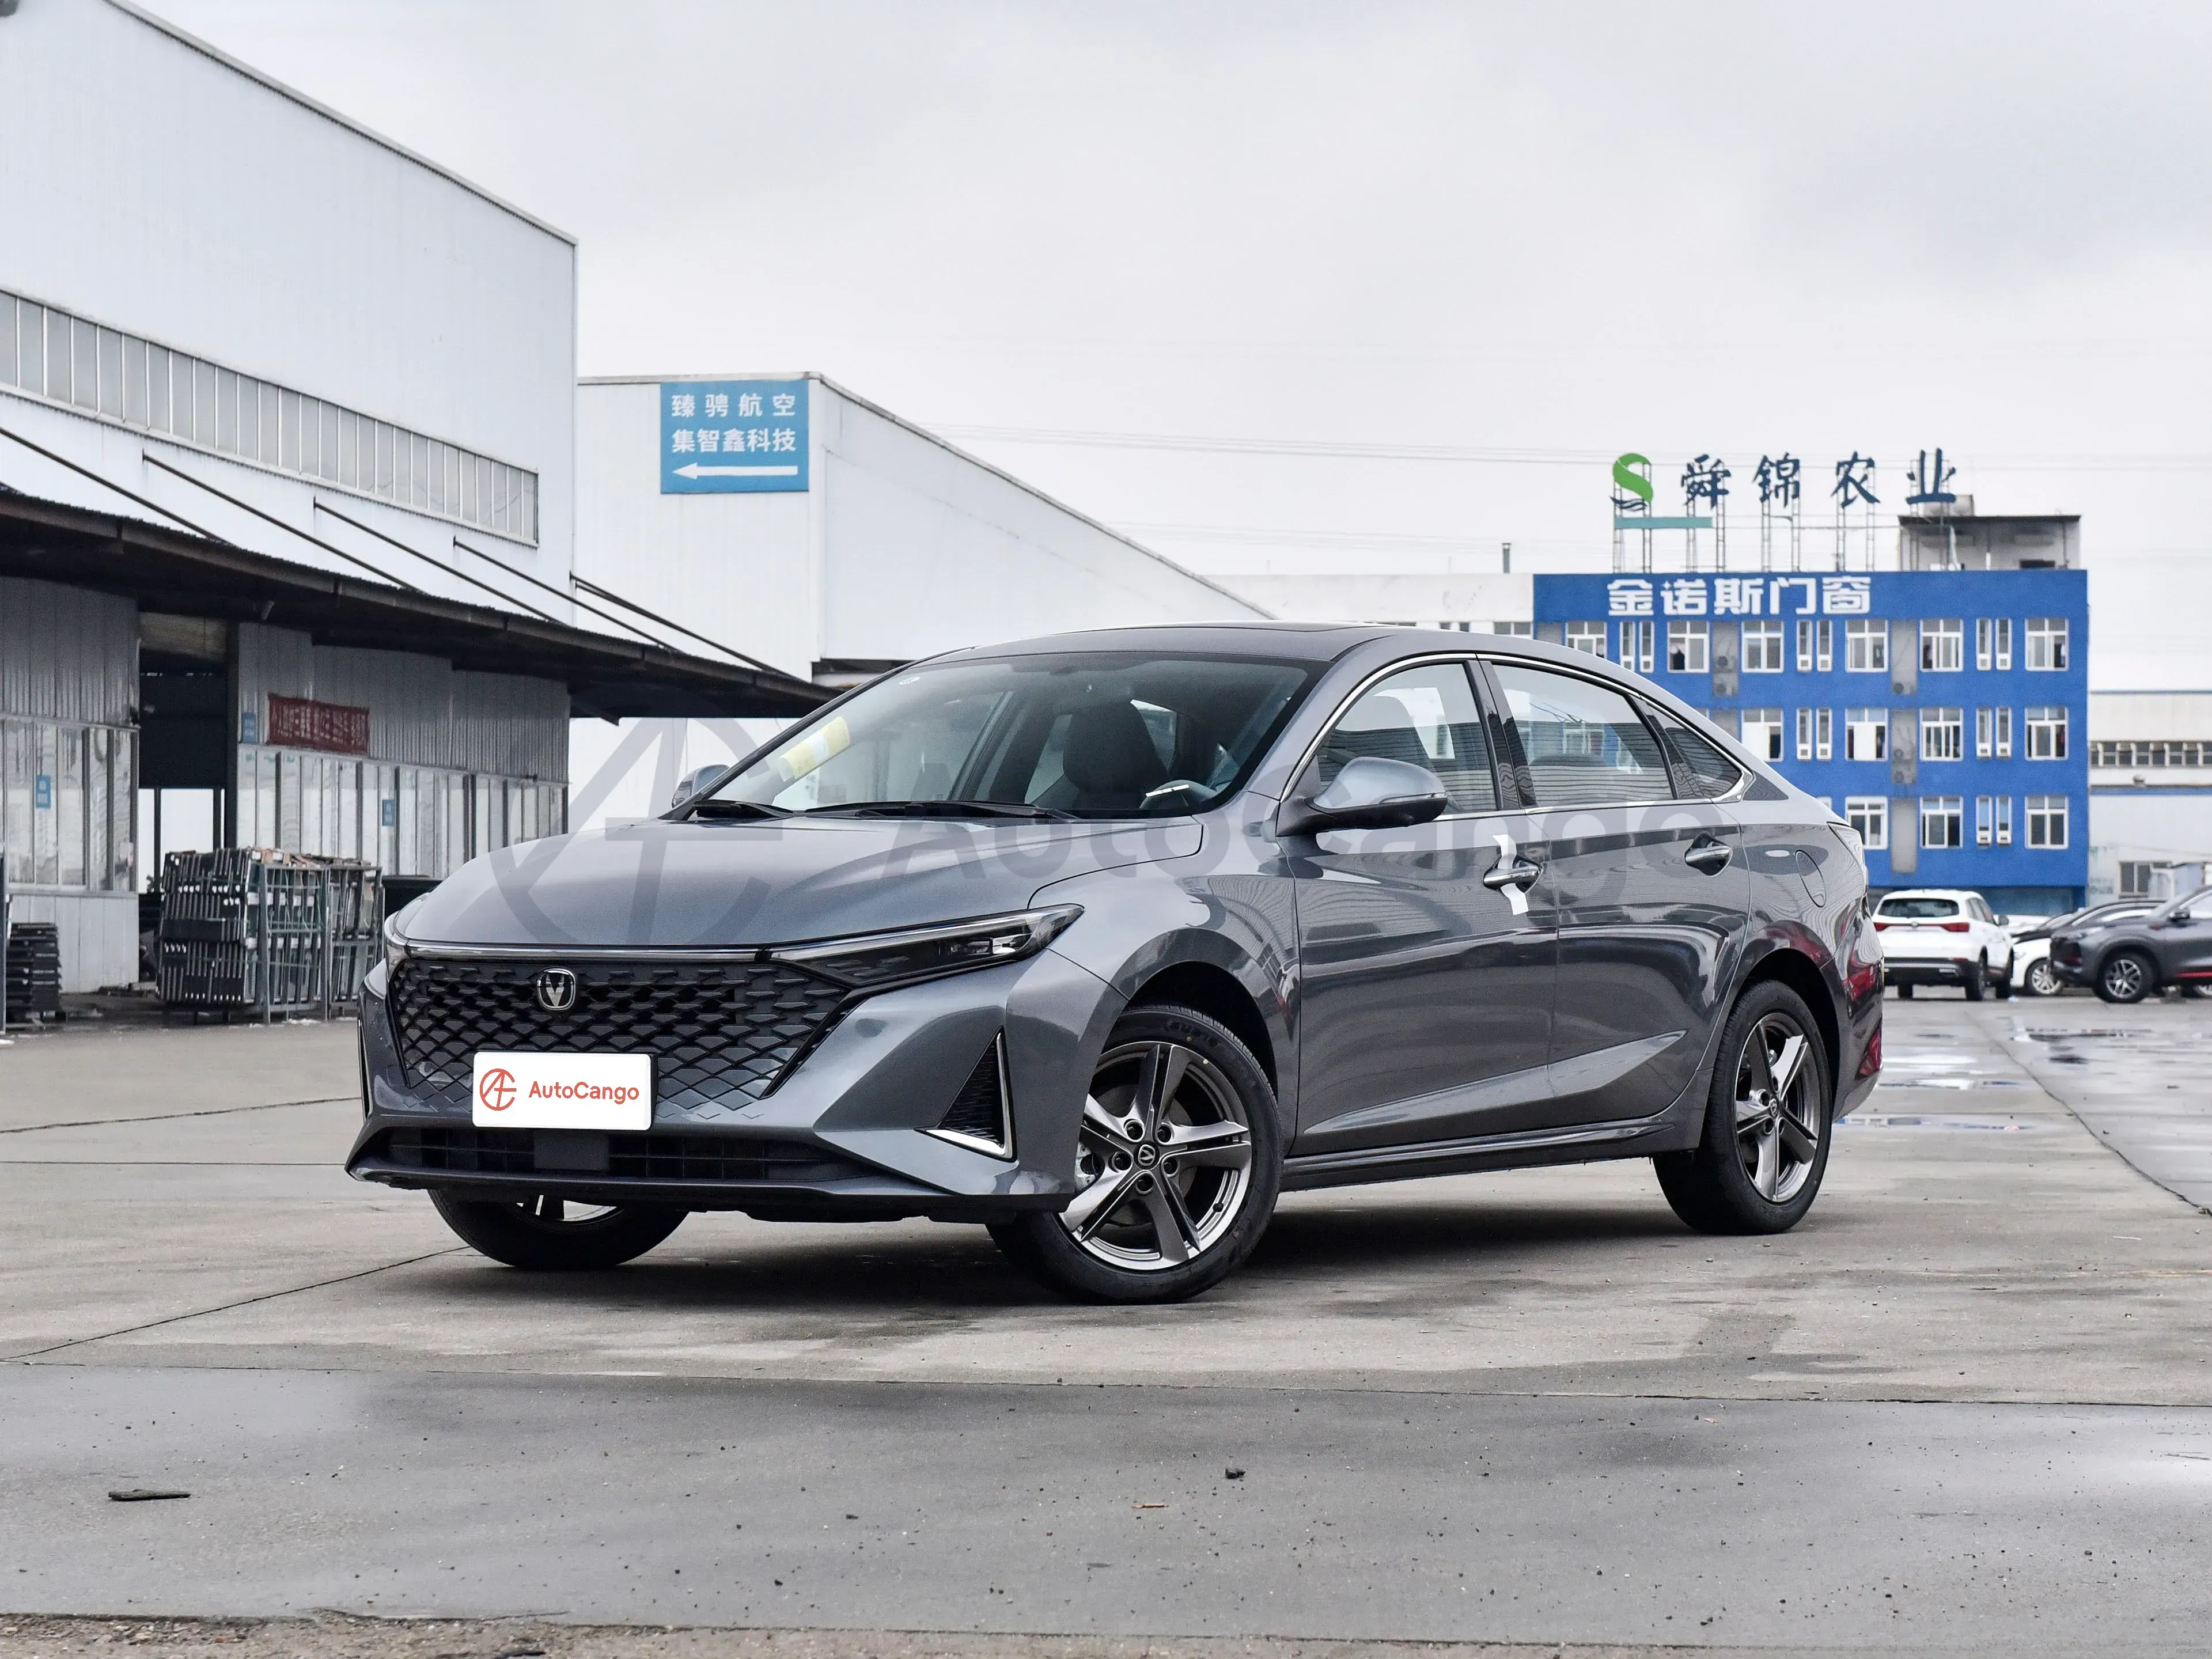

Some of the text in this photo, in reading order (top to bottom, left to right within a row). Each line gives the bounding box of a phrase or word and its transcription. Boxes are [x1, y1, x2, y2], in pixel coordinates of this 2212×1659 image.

[671, 393, 796, 418] 臻骋航空
[671, 427, 797, 453] 集智鑫科技
[1680, 447, 1957, 510] 舜锦农业
[1607, 576, 1872, 616] 金诺斯门窗
